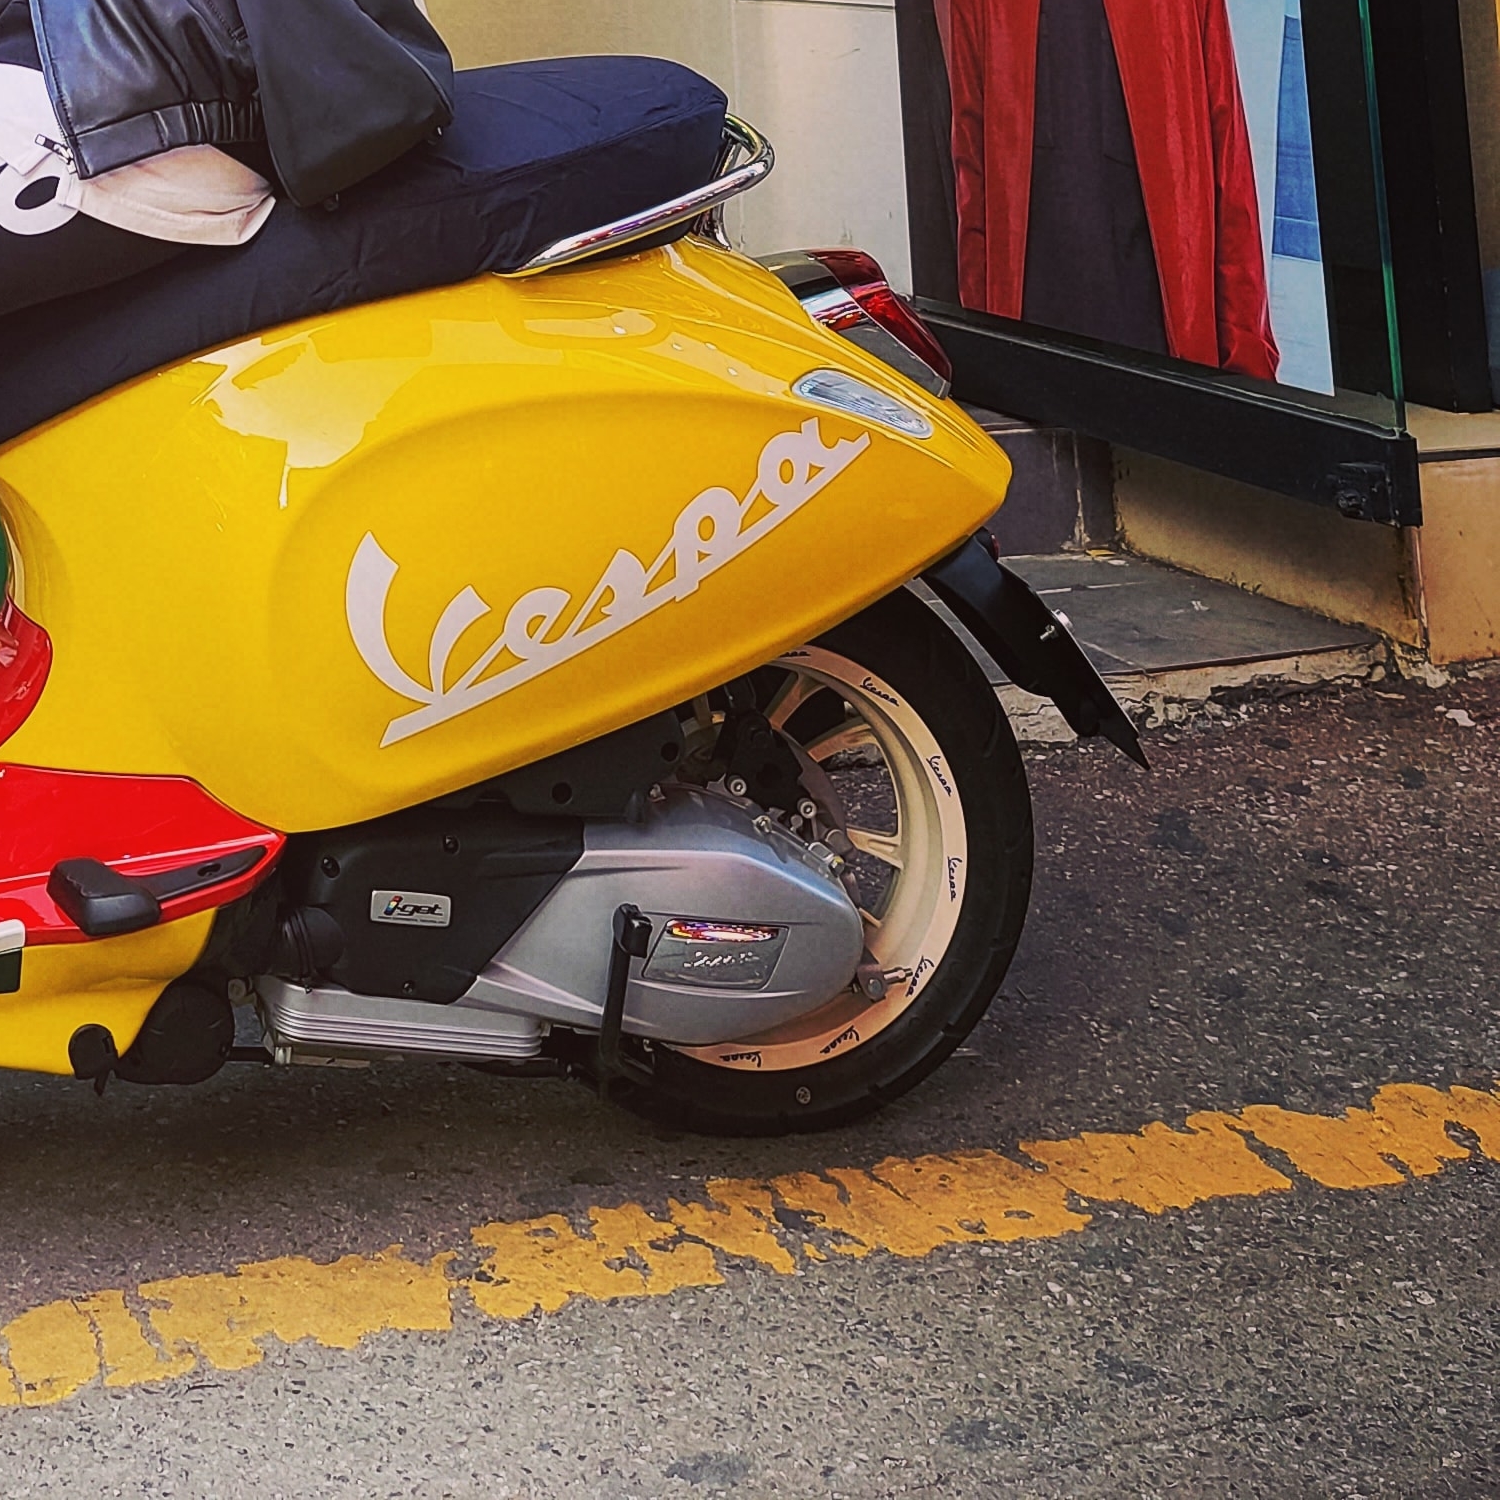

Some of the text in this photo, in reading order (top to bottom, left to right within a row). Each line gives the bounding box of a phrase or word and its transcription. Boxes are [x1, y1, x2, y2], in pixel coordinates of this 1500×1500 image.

[345, 417, 871, 749] Vespa
[859, 676, 900, 707] Vespa
[926, 755, 952, 797] Vespa
[947, 856, 963, 903] Vespa
[383, 895, 444, 917] i-get
[905, 955, 935, 998] Vespa
[819, 1024, 860, 1054] Vespa
[719, 1050, 762, 1068] Vespa
